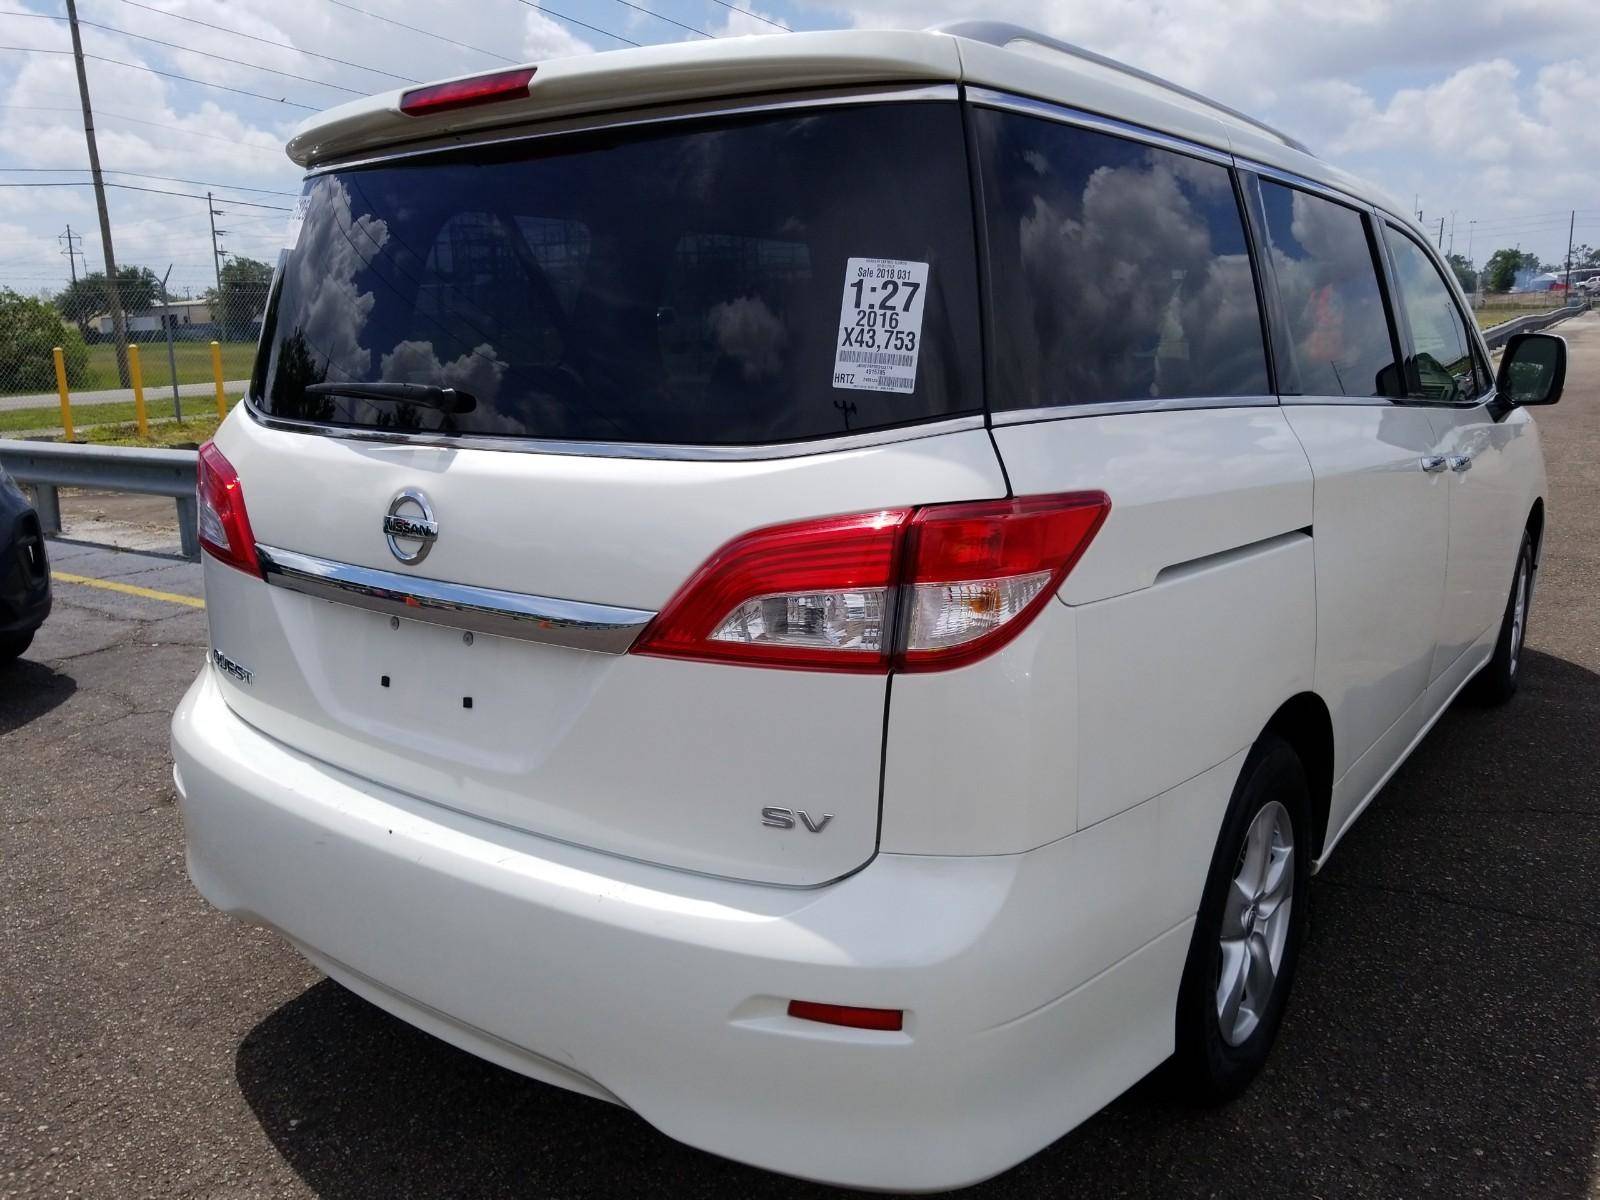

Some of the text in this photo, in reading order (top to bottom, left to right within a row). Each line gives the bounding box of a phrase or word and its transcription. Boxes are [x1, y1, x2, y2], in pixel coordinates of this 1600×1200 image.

[857, 267, 911, 281] Sale 2018 031
[850, 279, 920, 313] 1:27
[856, 310, 899, 329] 2016
[841, 327, 916, 352] X43,753
[834, 373, 855, 384] HRTZ
[385, 517, 432, 537] NISSAN
[213, 649, 253, 687] QUEST
[761, 806, 835, 833] SV
